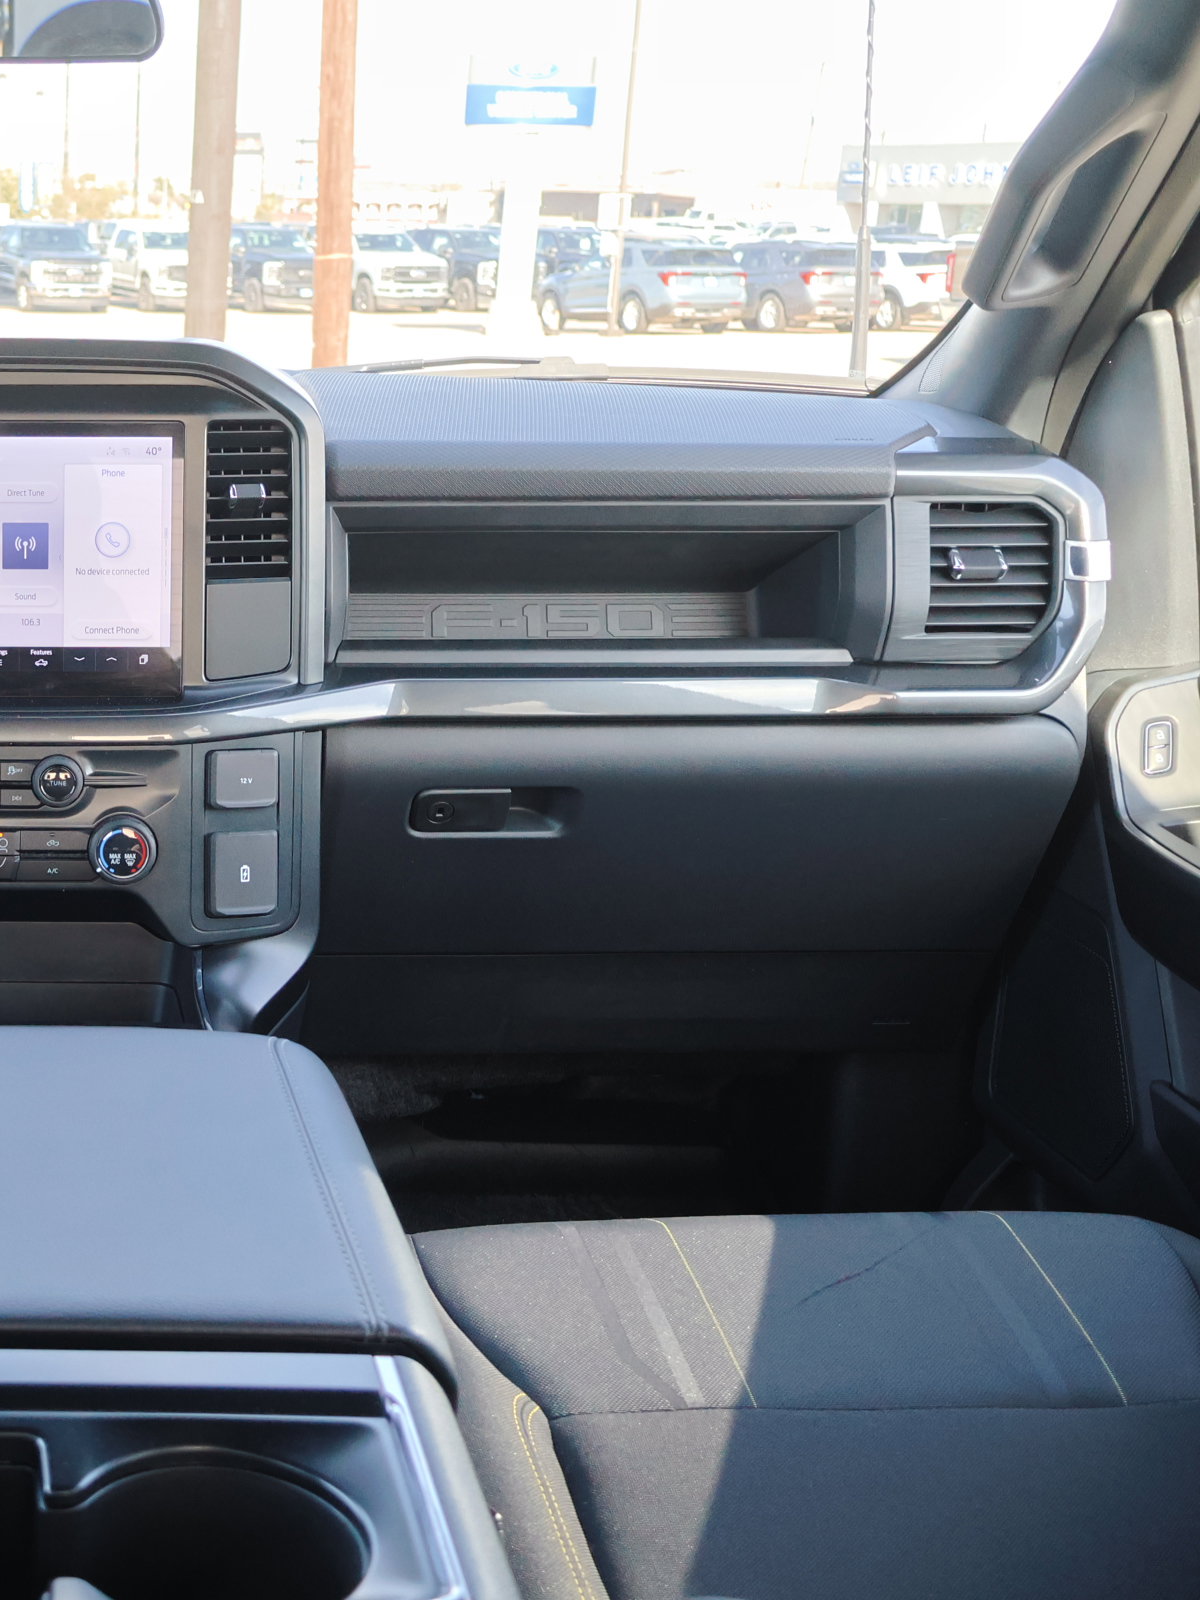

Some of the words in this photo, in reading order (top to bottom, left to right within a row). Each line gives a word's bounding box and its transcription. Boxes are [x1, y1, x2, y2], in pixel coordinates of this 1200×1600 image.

[101, 469, 125, 478] Phone
[7, 489, 27, 497] Direct
[28, 489, 44, 497] Tune
[21, 618, 40, 626] 106.3
[431, 603, 664, 637] F-150
[85, 626, 114, 634] Connect
[116, 626, 139, 634] Phone
